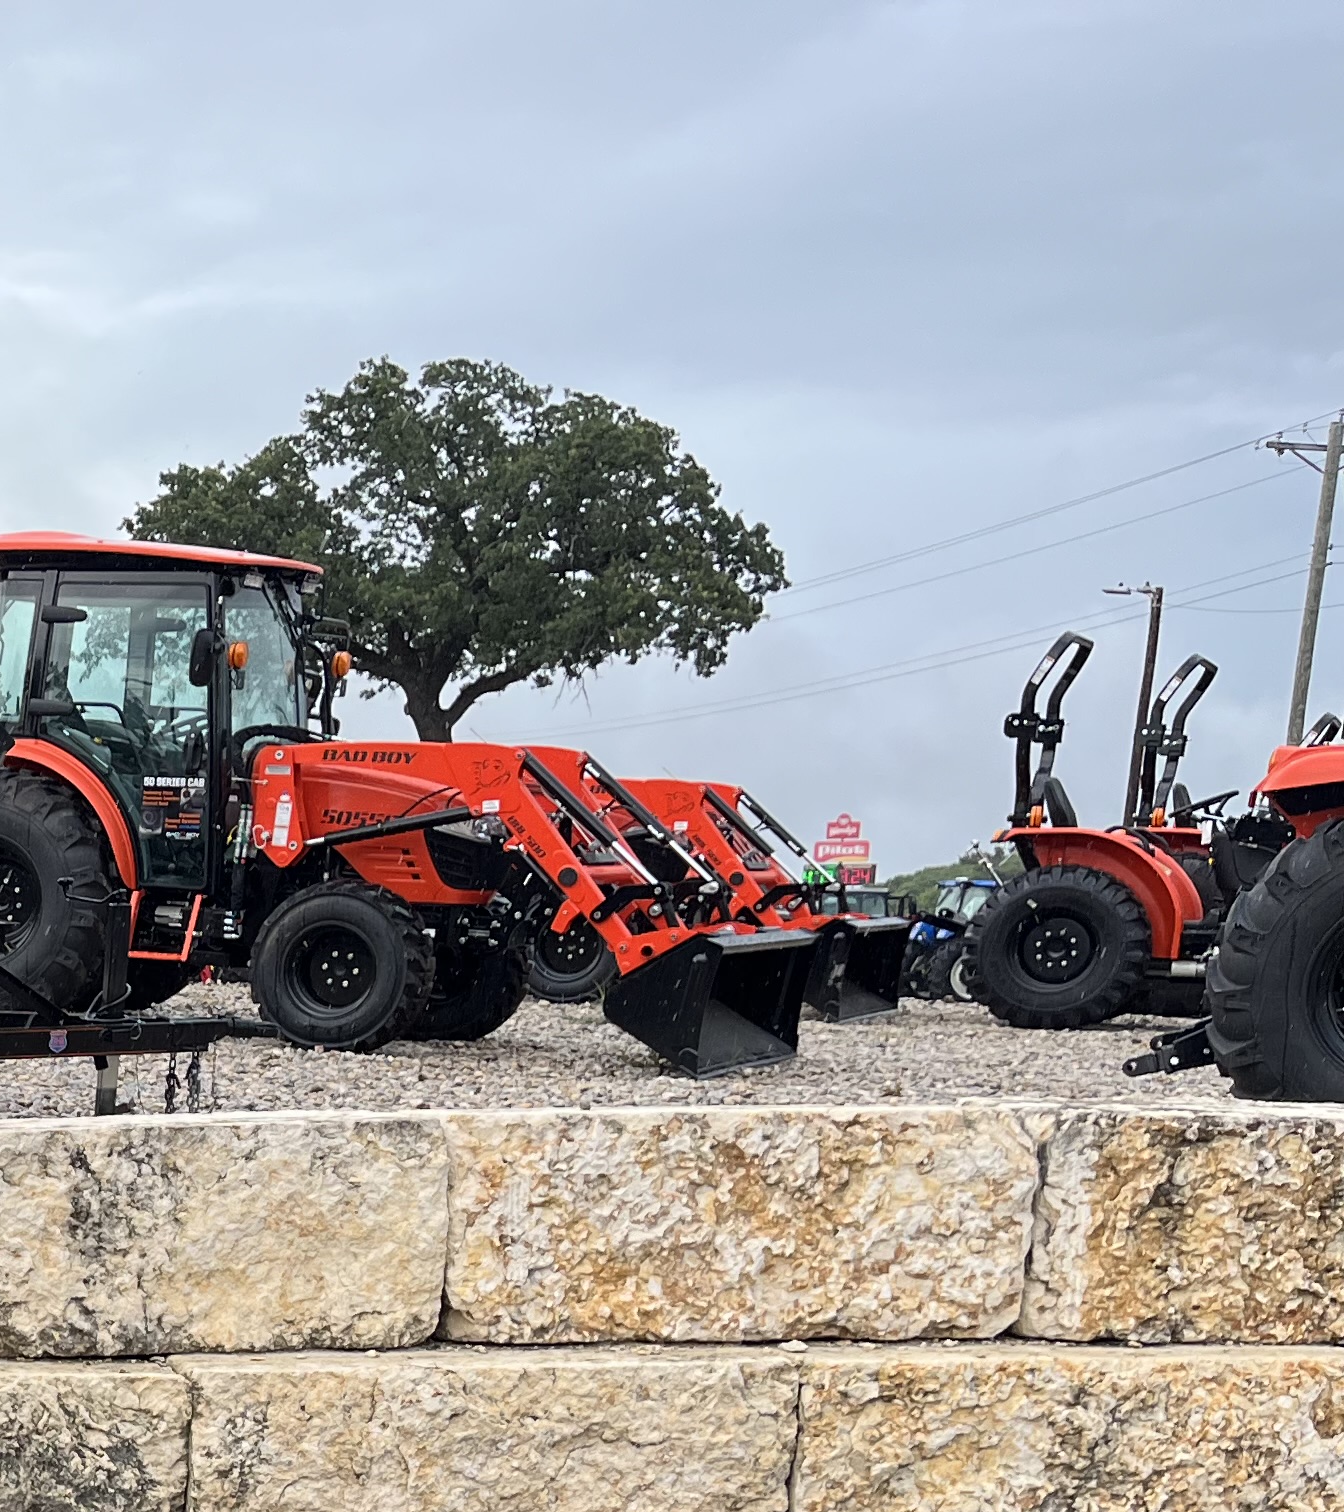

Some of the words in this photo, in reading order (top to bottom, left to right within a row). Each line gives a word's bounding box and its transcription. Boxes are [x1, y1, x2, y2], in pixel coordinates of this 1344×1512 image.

[321, 748, 368, 763] BAD
[370, 751, 418, 765] BOY
[187, 777, 205, 788] CAB
